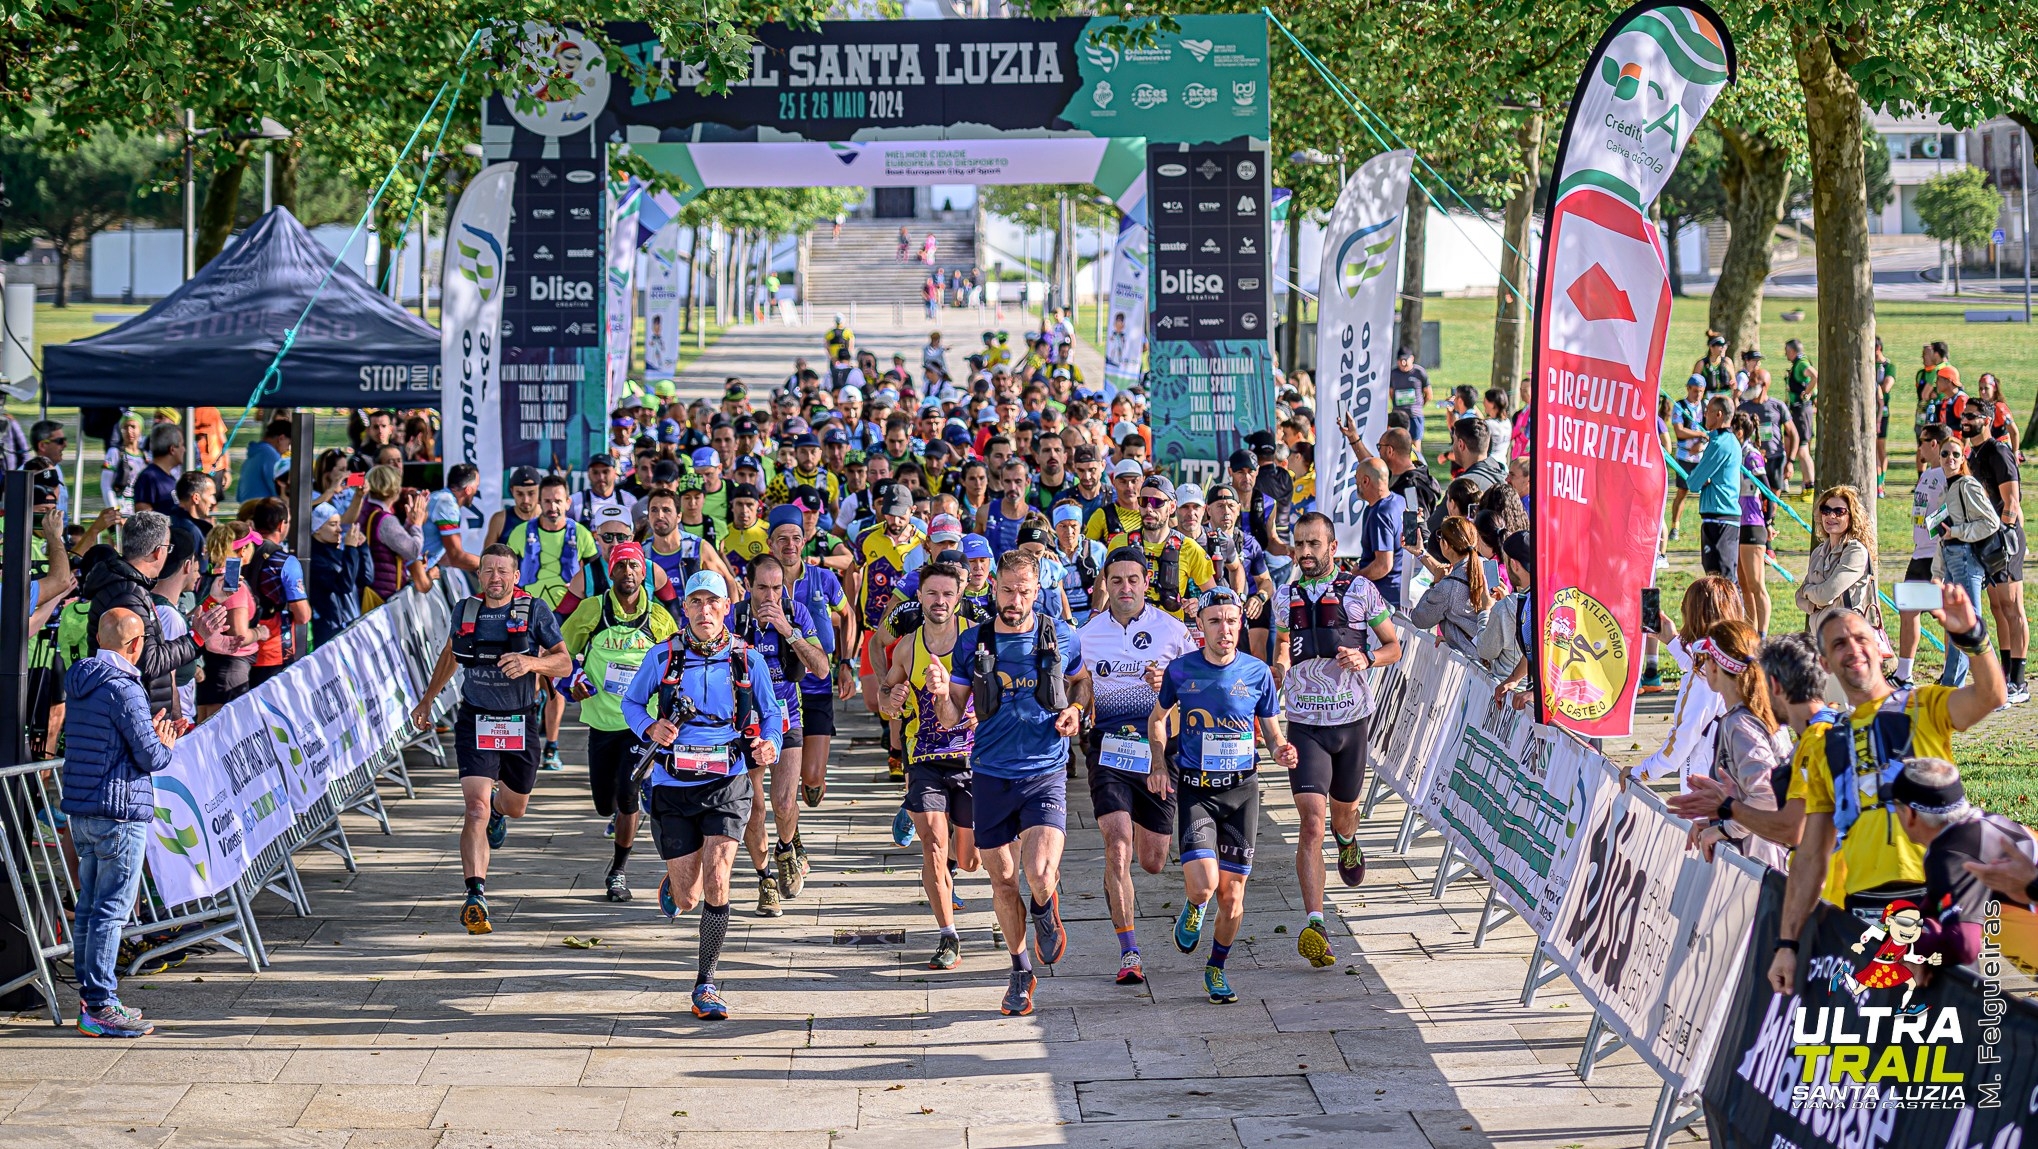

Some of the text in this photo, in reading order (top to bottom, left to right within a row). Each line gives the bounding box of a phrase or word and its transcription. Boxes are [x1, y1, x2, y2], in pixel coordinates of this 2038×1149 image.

[789, 44, 925, 87] SANTA
[935, 42, 1064, 84] LUZIA
[1138, 88, 1168, 96] aces
[1188, 87, 1218, 96] aces
[779, 90, 904, 119] 25 E 26 MAIO 2024
[929, 150, 966, 158] CIDADE
[1606, 139, 1630, 159] Caixa
[1160, 242, 1187, 251] mute
[360, 365, 407, 392] STOP
[501, 364, 519, 381] MINI
[519, 384, 569, 401] TRAIL SPRINT
[1188, 375, 1237, 393] TRAIL SPRINT
[520, 403, 567, 420] TRAIL LONGO
[1190, 395, 1236, 412] TRAIL LONGO
[520, 422, 566, 440] ULTRA TRAIL
[1190, 414, 1236, 431] ULTRA TRAIL
[1580, 598, 1624, 660] ATLETISMO
[1111, 660, 1142, 672] Zenit
[1296, 690, 1354, 703] HERBALIFE
[1296, 699, 1355, 711] NUTRITION
[494, 738, 507, 749] 64
[1115, 756, 1134, 770] 277
[1219, 758, 1238, 770] 265
[1183, 771, 1232, 788] naked
